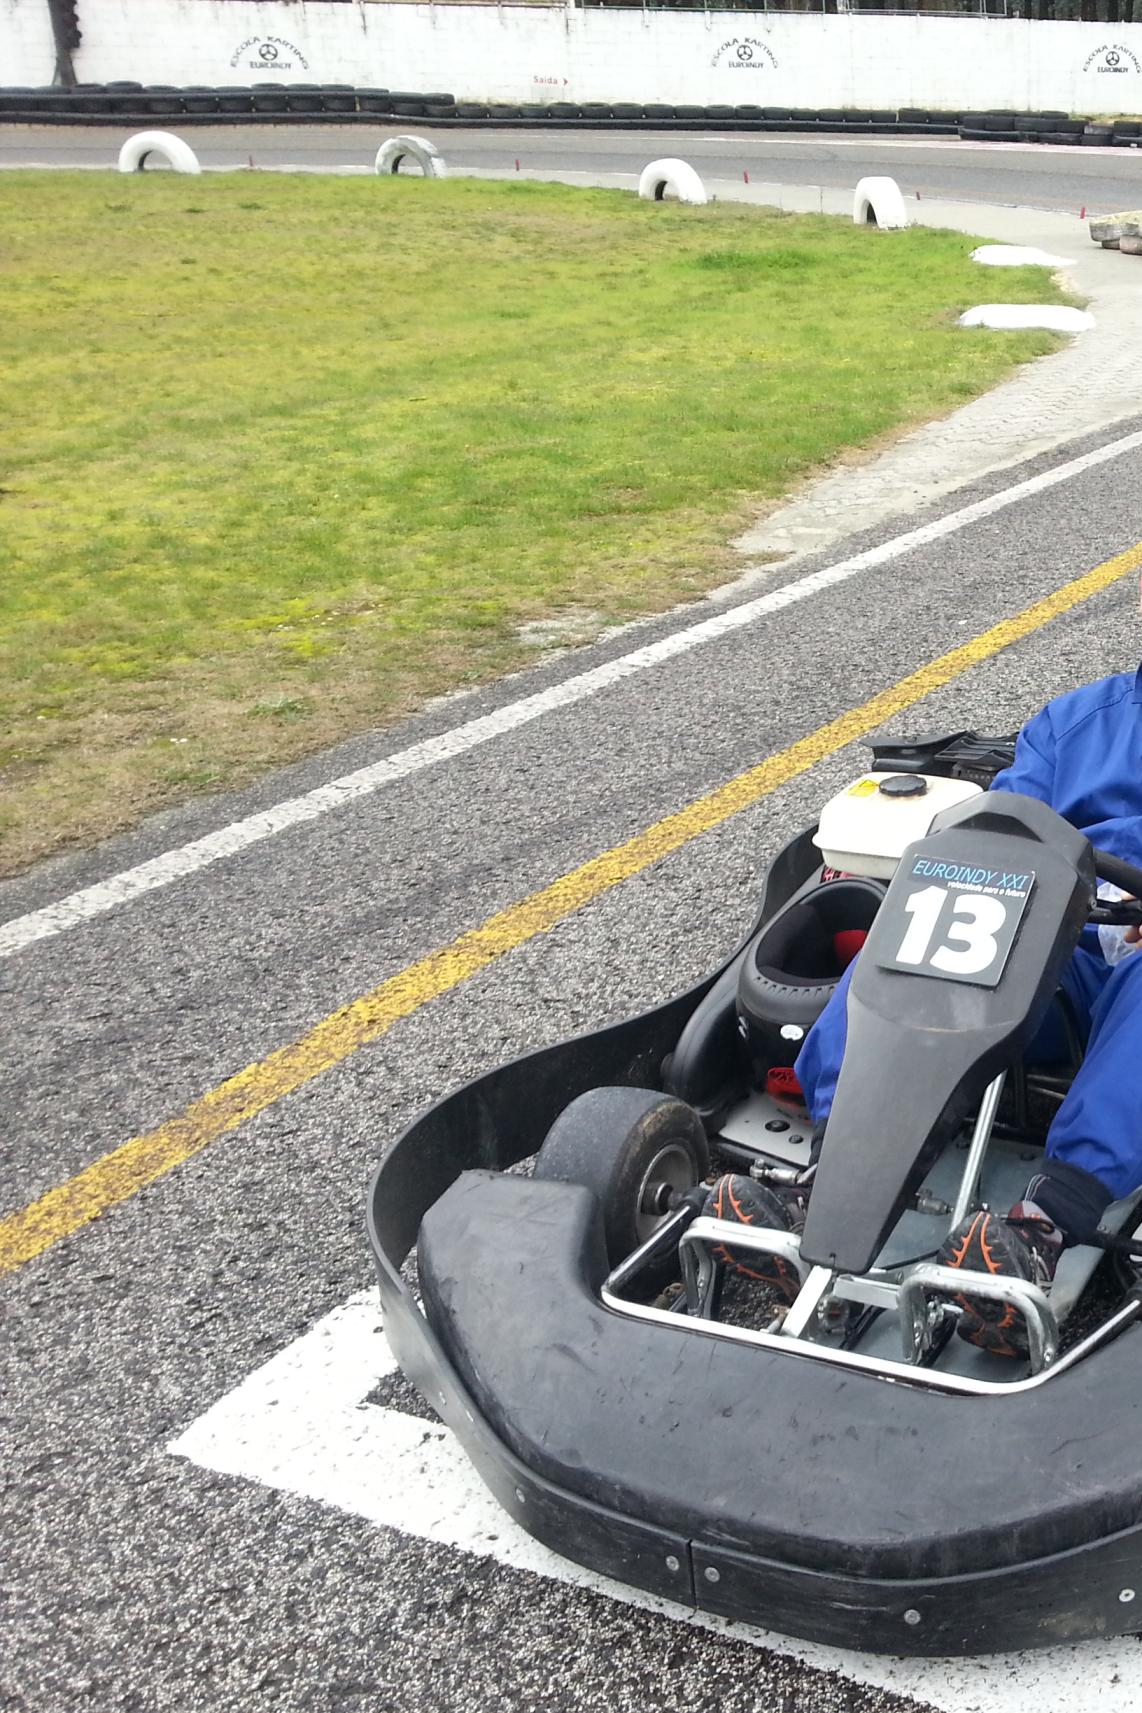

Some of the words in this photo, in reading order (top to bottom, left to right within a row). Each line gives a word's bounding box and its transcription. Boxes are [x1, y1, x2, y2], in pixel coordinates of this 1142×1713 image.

[229, 36, 261, 68] ESCOLA
[267, 36, 310, 70] KARTING
[249, 61, 292, 69] EUROINDY
[711, 38, 739, 68] ESCOLA
[744, 37, 779, 69] KARTING
[728, 61, 765, 69] EUROINDY
[1082, 44, 1109, 73] ESCOLA
[1112, 44, 1142, 74] KARTING
[912, 860, 998, 885] EUROINDY
[996, 872, 1030, 890] XXI
[895, 885, 1007, 975] 13
